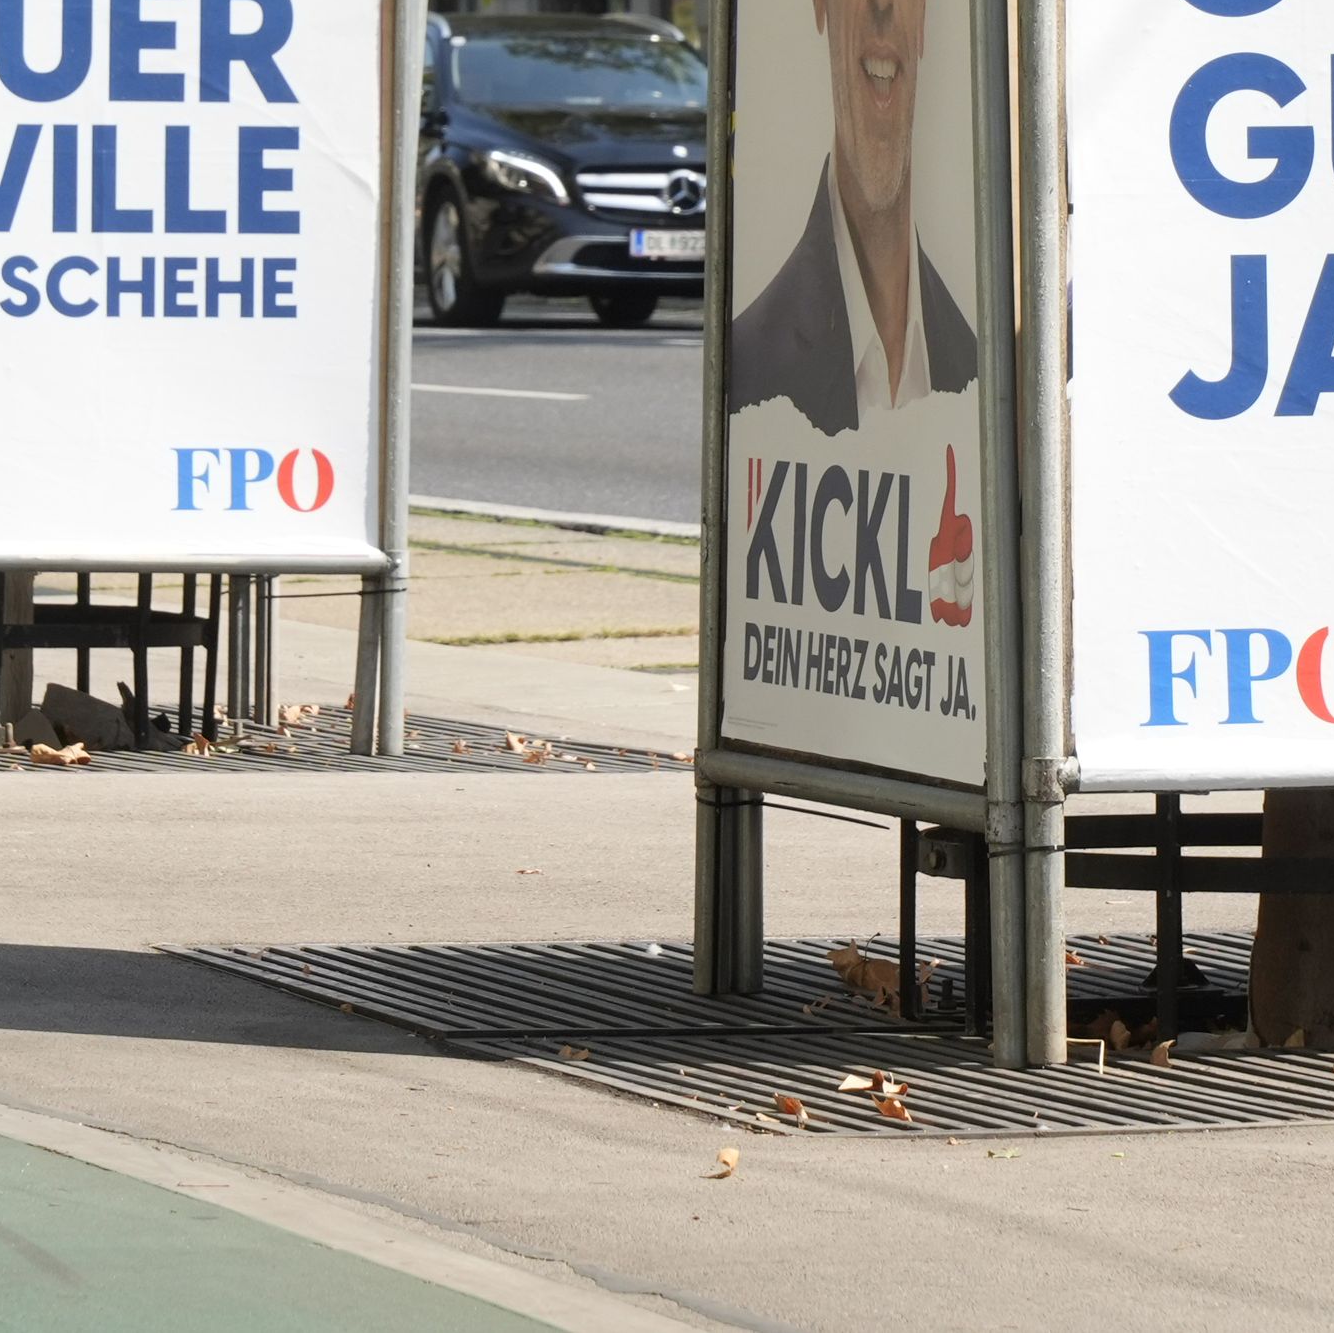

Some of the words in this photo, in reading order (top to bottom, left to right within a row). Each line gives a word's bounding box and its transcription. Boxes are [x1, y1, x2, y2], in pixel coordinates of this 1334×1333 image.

[746, 458, 922, 625] KICKL
[743, 622, 802, 688] DEIN
[805, 631, 870, 700] HERZ
[872, 642, 936, 712] SAGT
[939, 655, 977, 722] JA.
